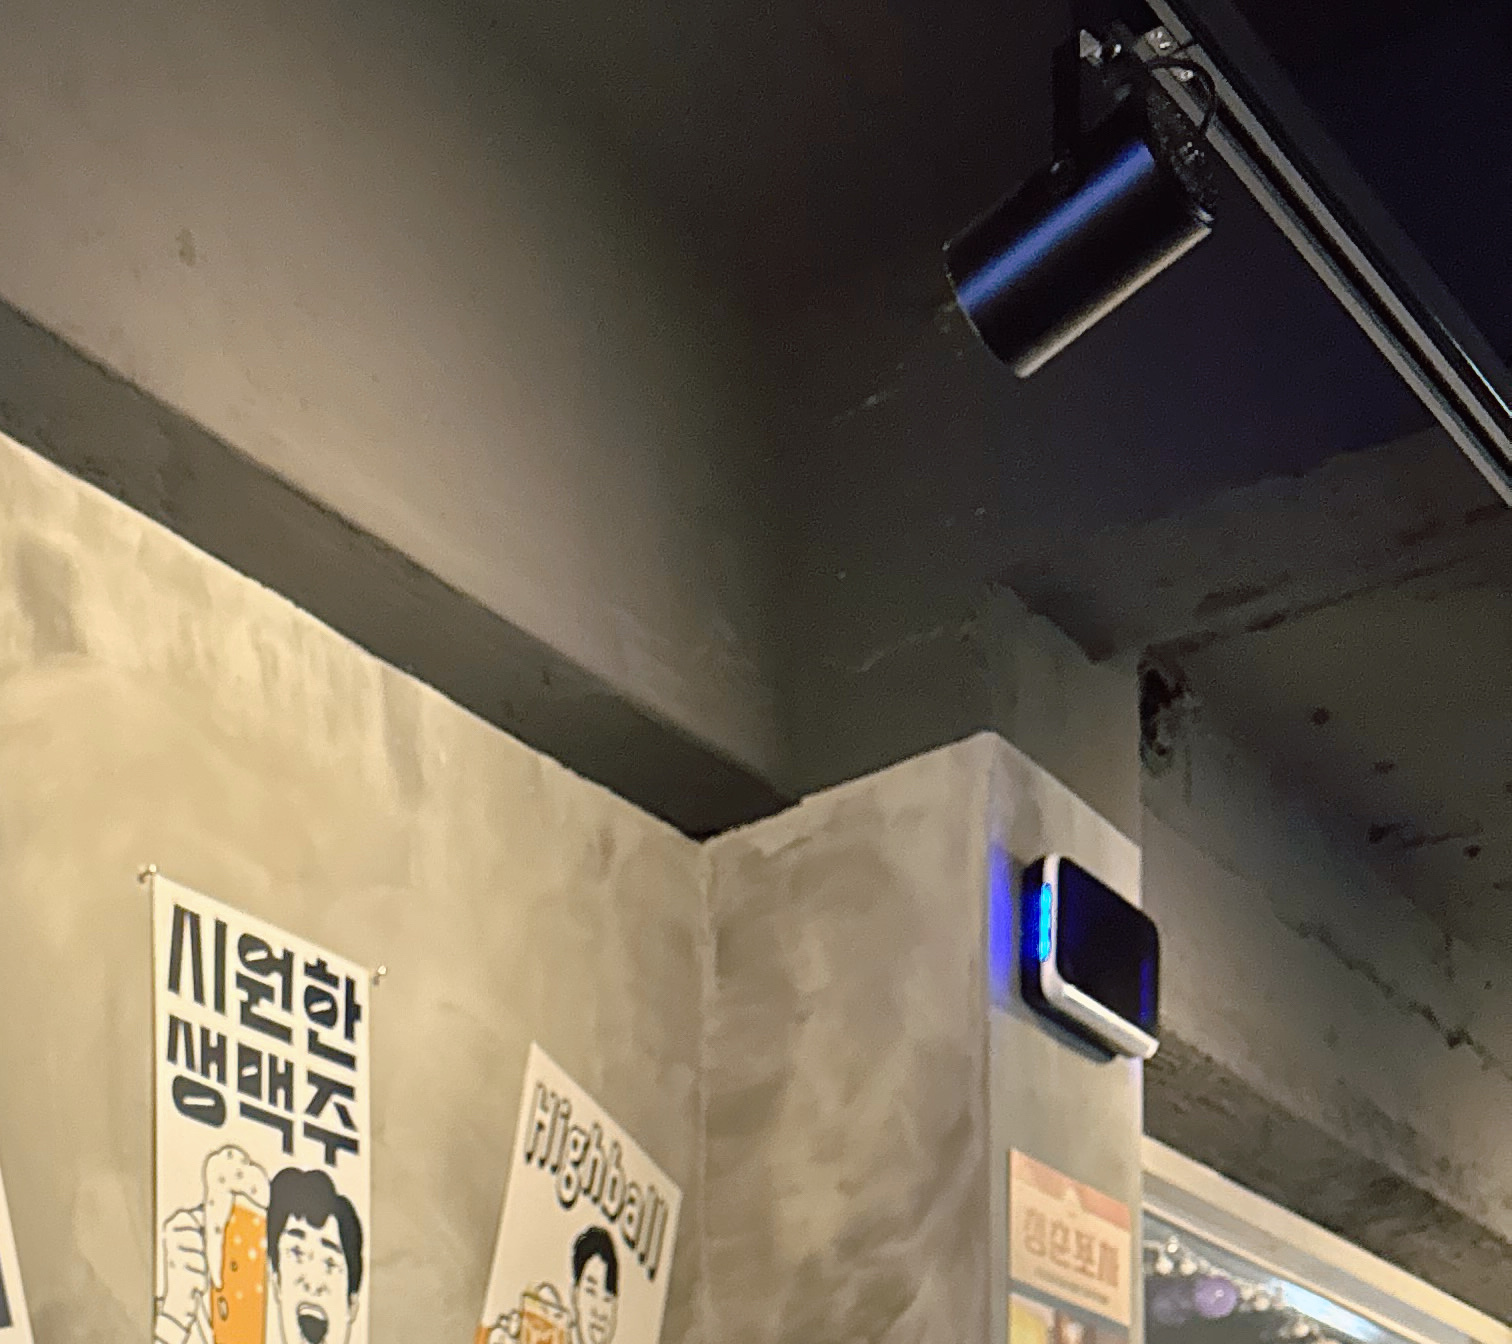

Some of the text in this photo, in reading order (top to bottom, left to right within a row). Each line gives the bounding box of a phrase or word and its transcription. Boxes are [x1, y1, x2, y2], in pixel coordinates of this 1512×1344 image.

[168, 903, 362, 1072] 시원한
[166, 1013, 361, 1167] 생맥주
[524, 1081, 669, 1282] Highball
